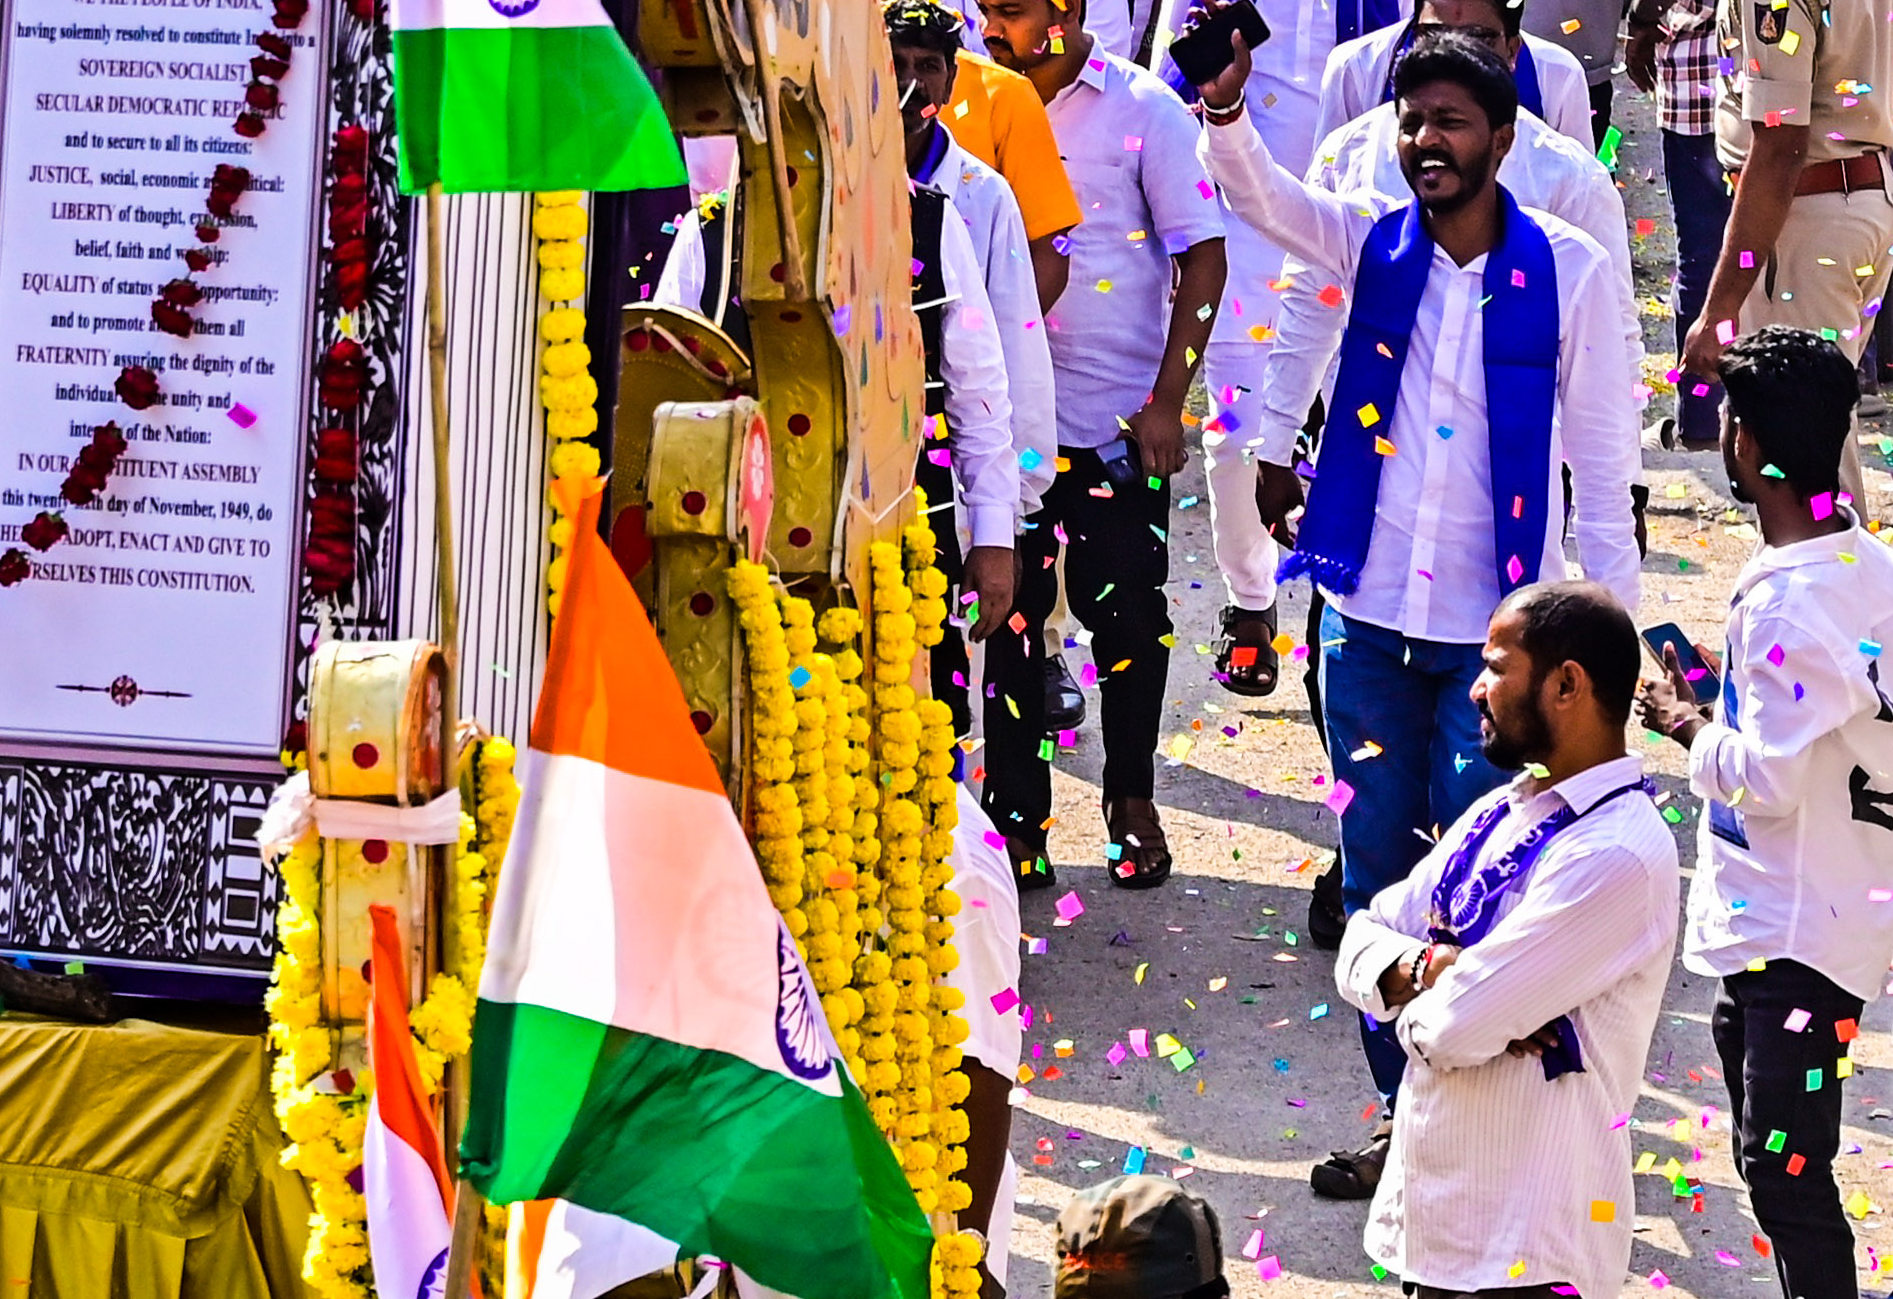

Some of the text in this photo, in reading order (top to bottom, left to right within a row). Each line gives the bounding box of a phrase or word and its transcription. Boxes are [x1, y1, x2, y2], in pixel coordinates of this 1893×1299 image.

[16, 21, 57, 44] having
[59, 22, 111, 41] solemnly
[115, 25, 166, 43] resolved
[168, 28, 181, 43] to
[183, 28, 242, 46] constitute
[79, 58, 246, 82] SOVEREIGN SOCIALIST
[36, 93, 208, 117] SECULAR DEMOCRATIC
[64, 131, 89, 149] and
[91, 134, 104, 149] to
[107, 136, 147, 151] secure
[149, 136, 162, 151] to
[164, 134, 181, 152] all
[183, 135, 199, 153] its
[28, 164, 200, 189] JUSTICE, social, economic
[16, 344, 108, 367] FRATERNITY
[169, 352, 189, 371] the
[192, 353, 235, 377] dignity
[239, 356, 254, 374] of
[255, 357, 275, 376] the
[18, 452, 261, 484] IN OUR ASSEMBLY
[2, 488, 25, 507] this
[106, 493, 130, 518] day
[132, 495, 148, 514] of
[149, 496, 217, 519] November,
[256, 503, 273, 521] do
[119, 530, 170, 552] ENACT
[174, 535, 205, 554] AND
[207, 536, 246, 556] GIVE
[249, 538, 271, 558] TO
[17, 560, 255, 594] RSELVES THIS CONSTITUTION.
